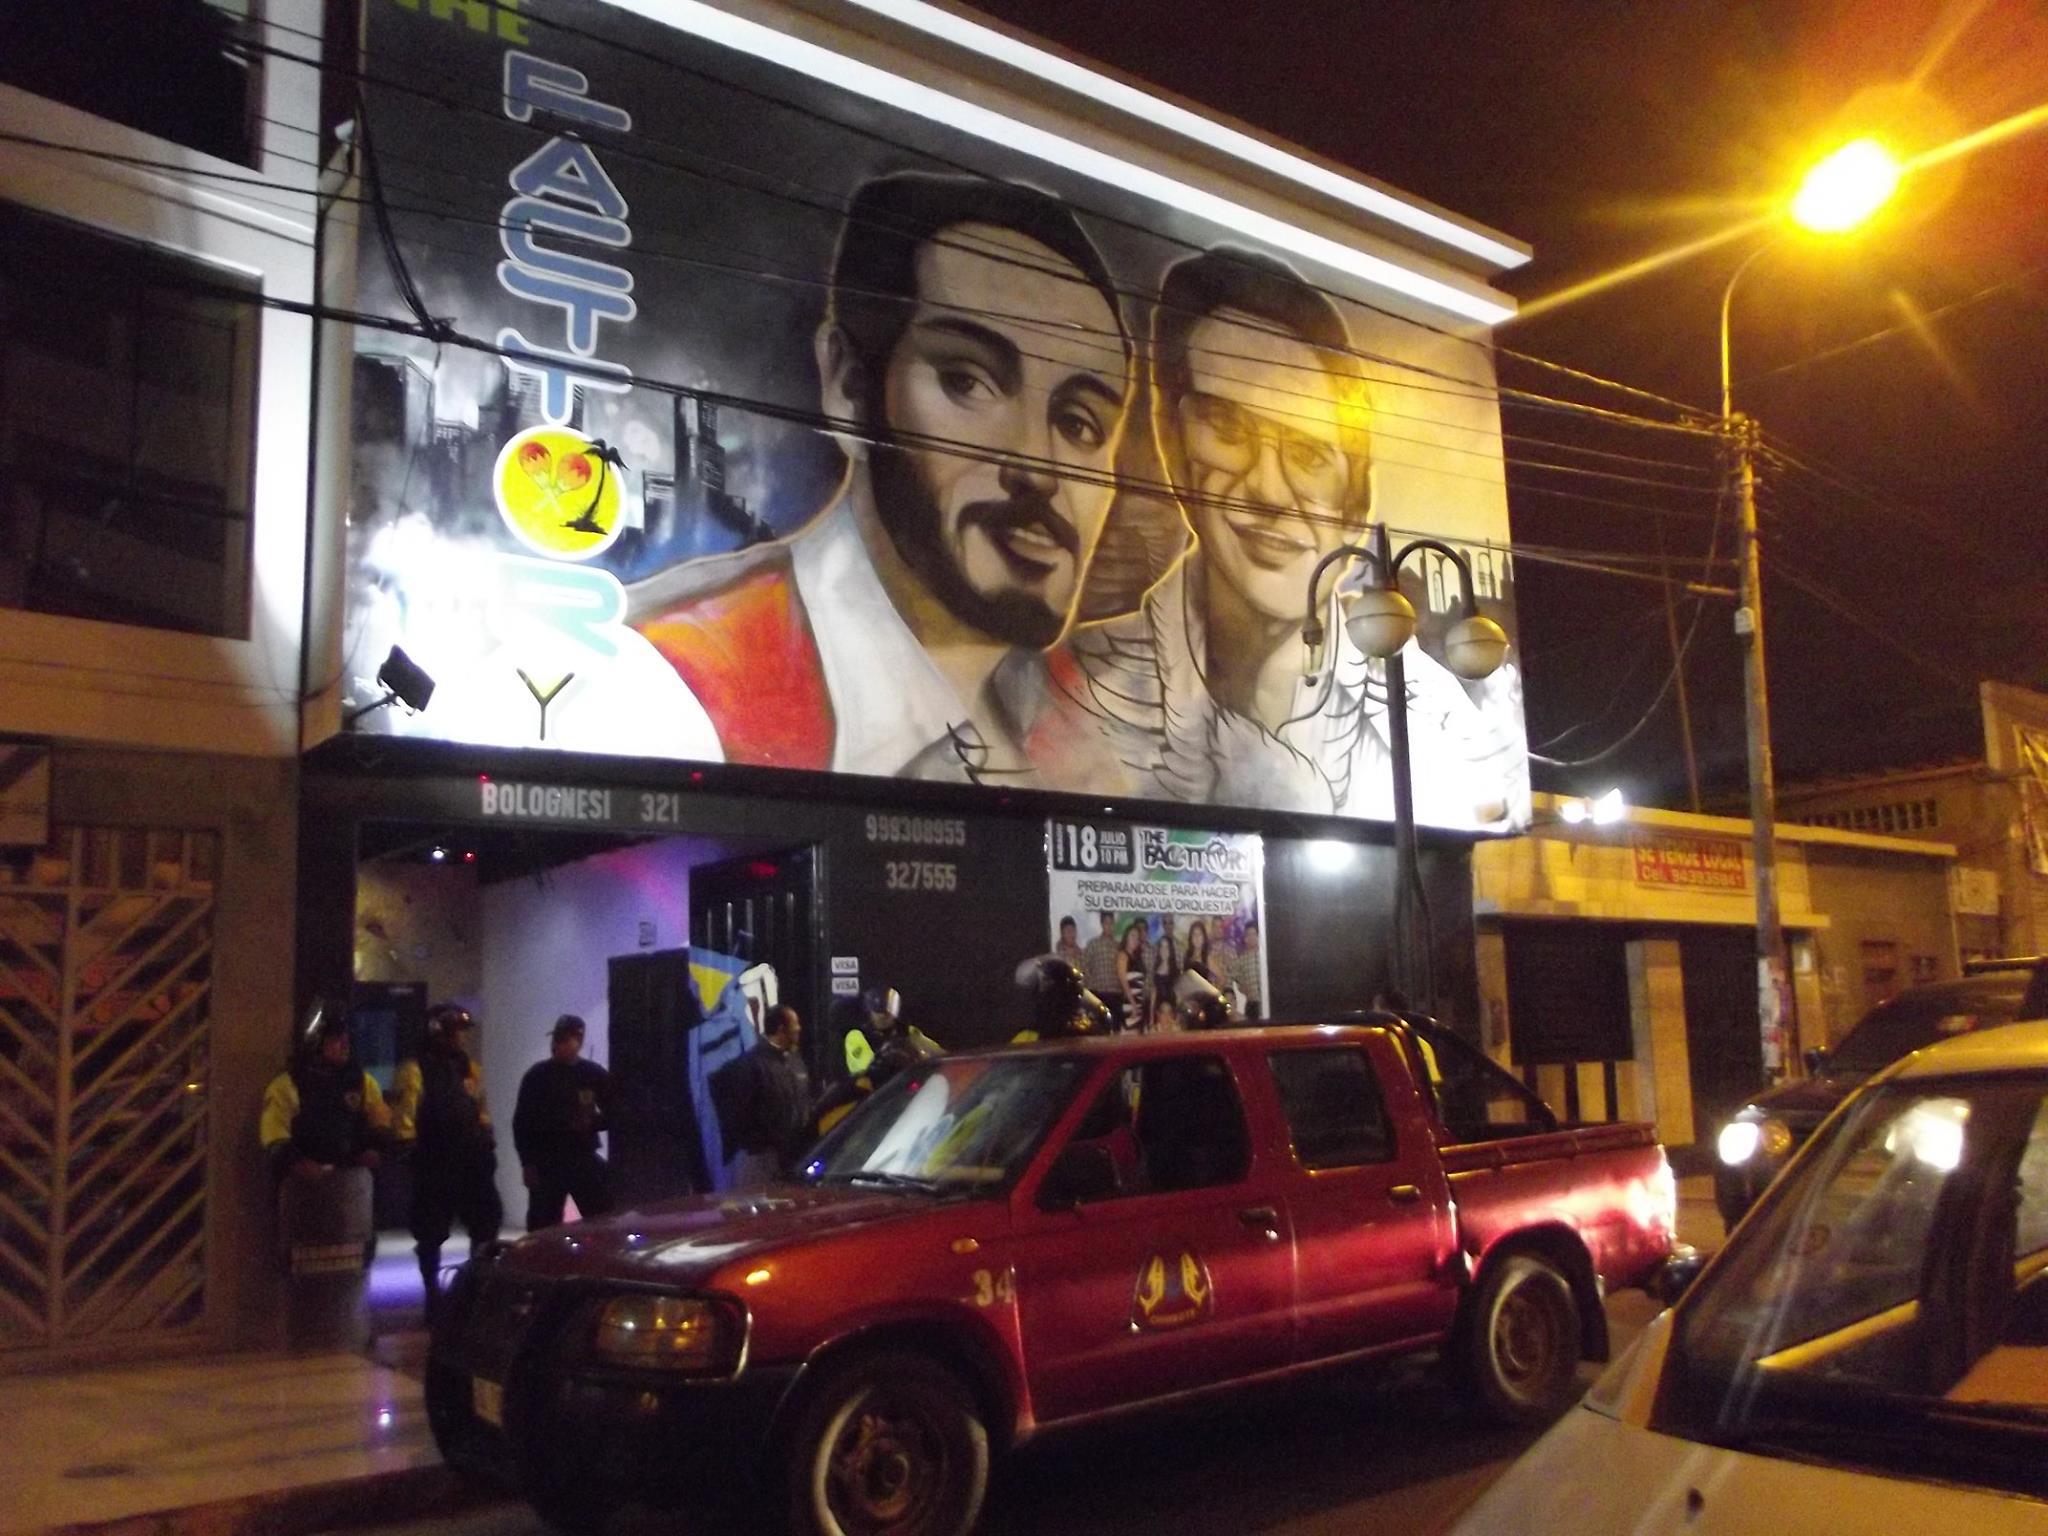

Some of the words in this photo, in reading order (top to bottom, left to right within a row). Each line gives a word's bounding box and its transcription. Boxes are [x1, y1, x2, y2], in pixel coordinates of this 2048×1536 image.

[391, 0, 529, 45] HE
[481, 783, 611, 820] BOLOGNESI
[640, 792, 679, 823] 321
[1066, 824, 1098, 868] 18
[1099, 831, 1126, 845] JULIO
[886, 861, 957, 891] 327555
[1171, 884, 1198, 896] PARA
[1200, 885, 1238, 898] HACER
[1085, 895, 1099, 908] SU
[1103, 896, 1157, 909] ENTRADA
[1158, 899, 1173, 910] LA
[1175, 899, 1233, 912] ORQUESTA
[834, 960, 857, 970] VISA
[834, 981, 857, 991] VISA
